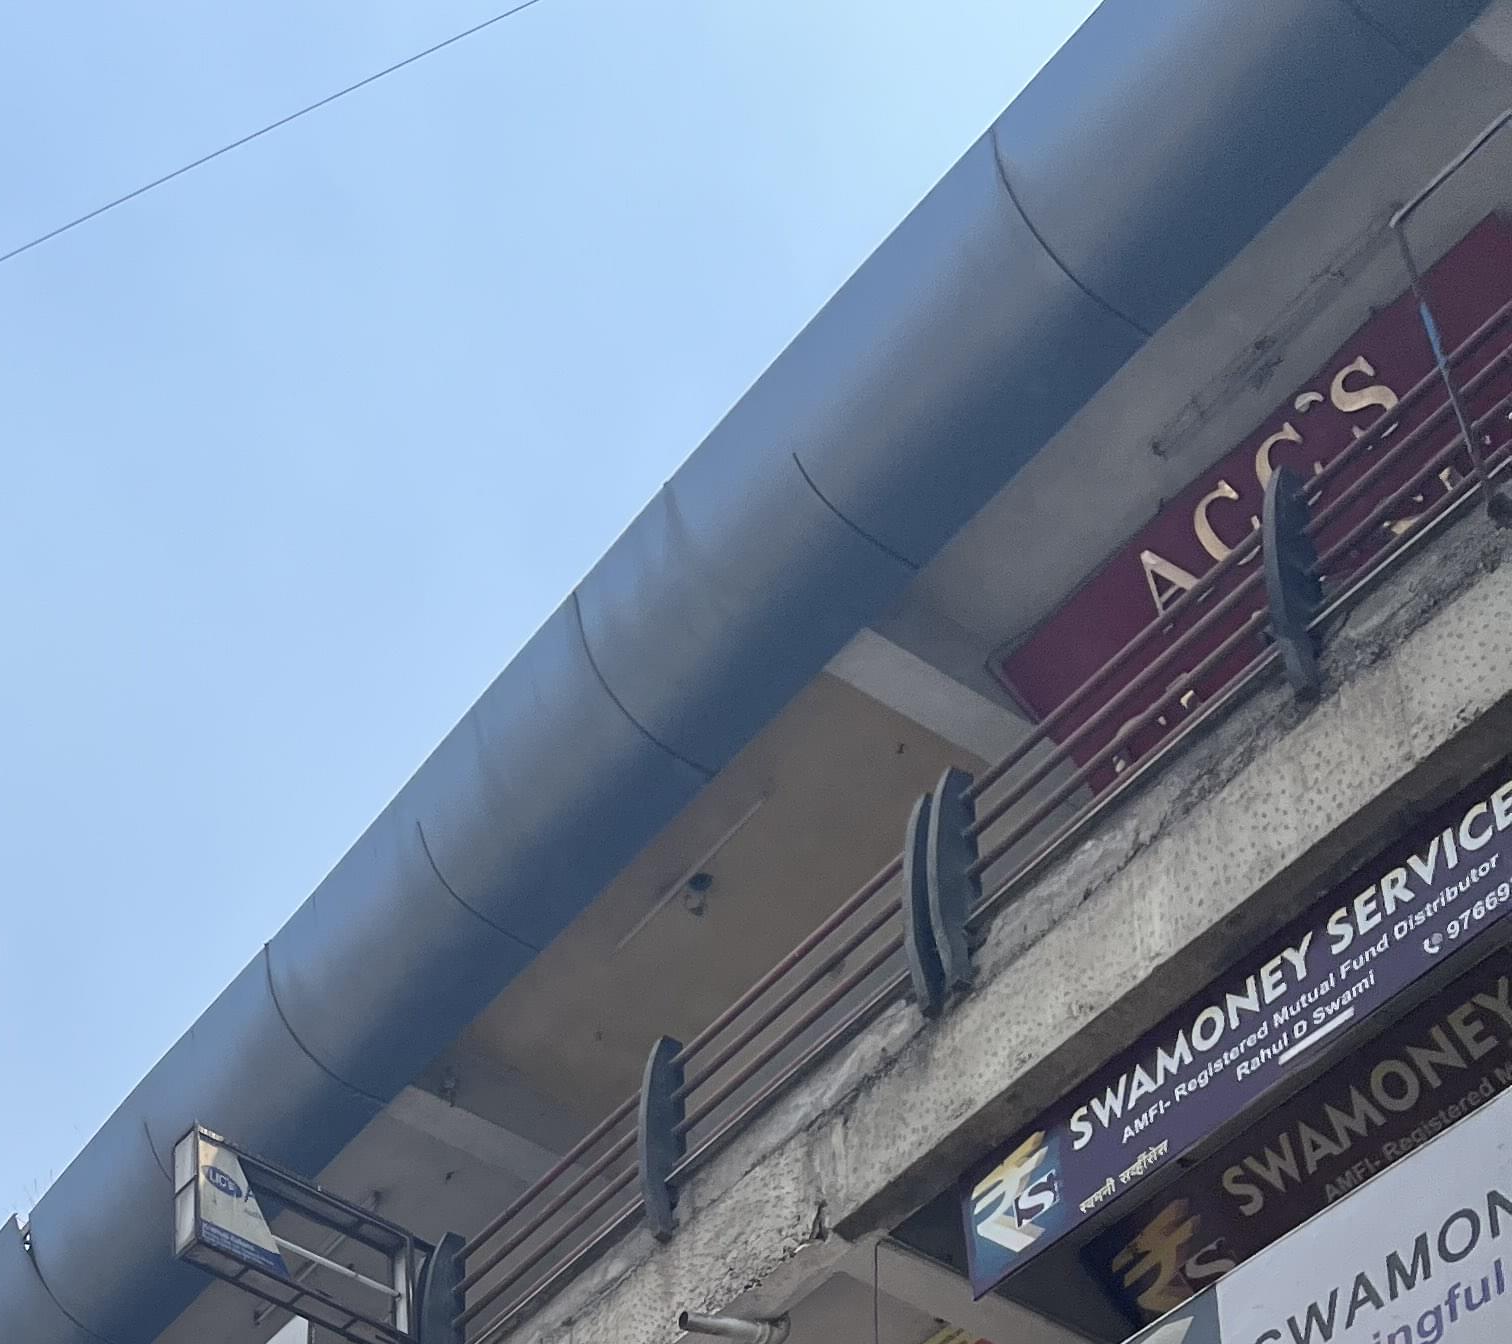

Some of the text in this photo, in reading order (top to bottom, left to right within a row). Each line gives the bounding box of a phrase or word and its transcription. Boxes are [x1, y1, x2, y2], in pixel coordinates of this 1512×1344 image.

[1070, 931, 1313, 1150] SWAMONEY
[1174, 1022, 1269, 1102] Registered
[1272, 972, 1335, 1029] Mutual
[1339, 933, 1389, 980] Fund
[1393, 853, 1499, 941] Distributor
[1236, 969, 1376, 1082] Rahul D Swami
[1222, 975, 1512, 1217] SWAMONEY
[1382, 1076, 1495, 1161] Registered
